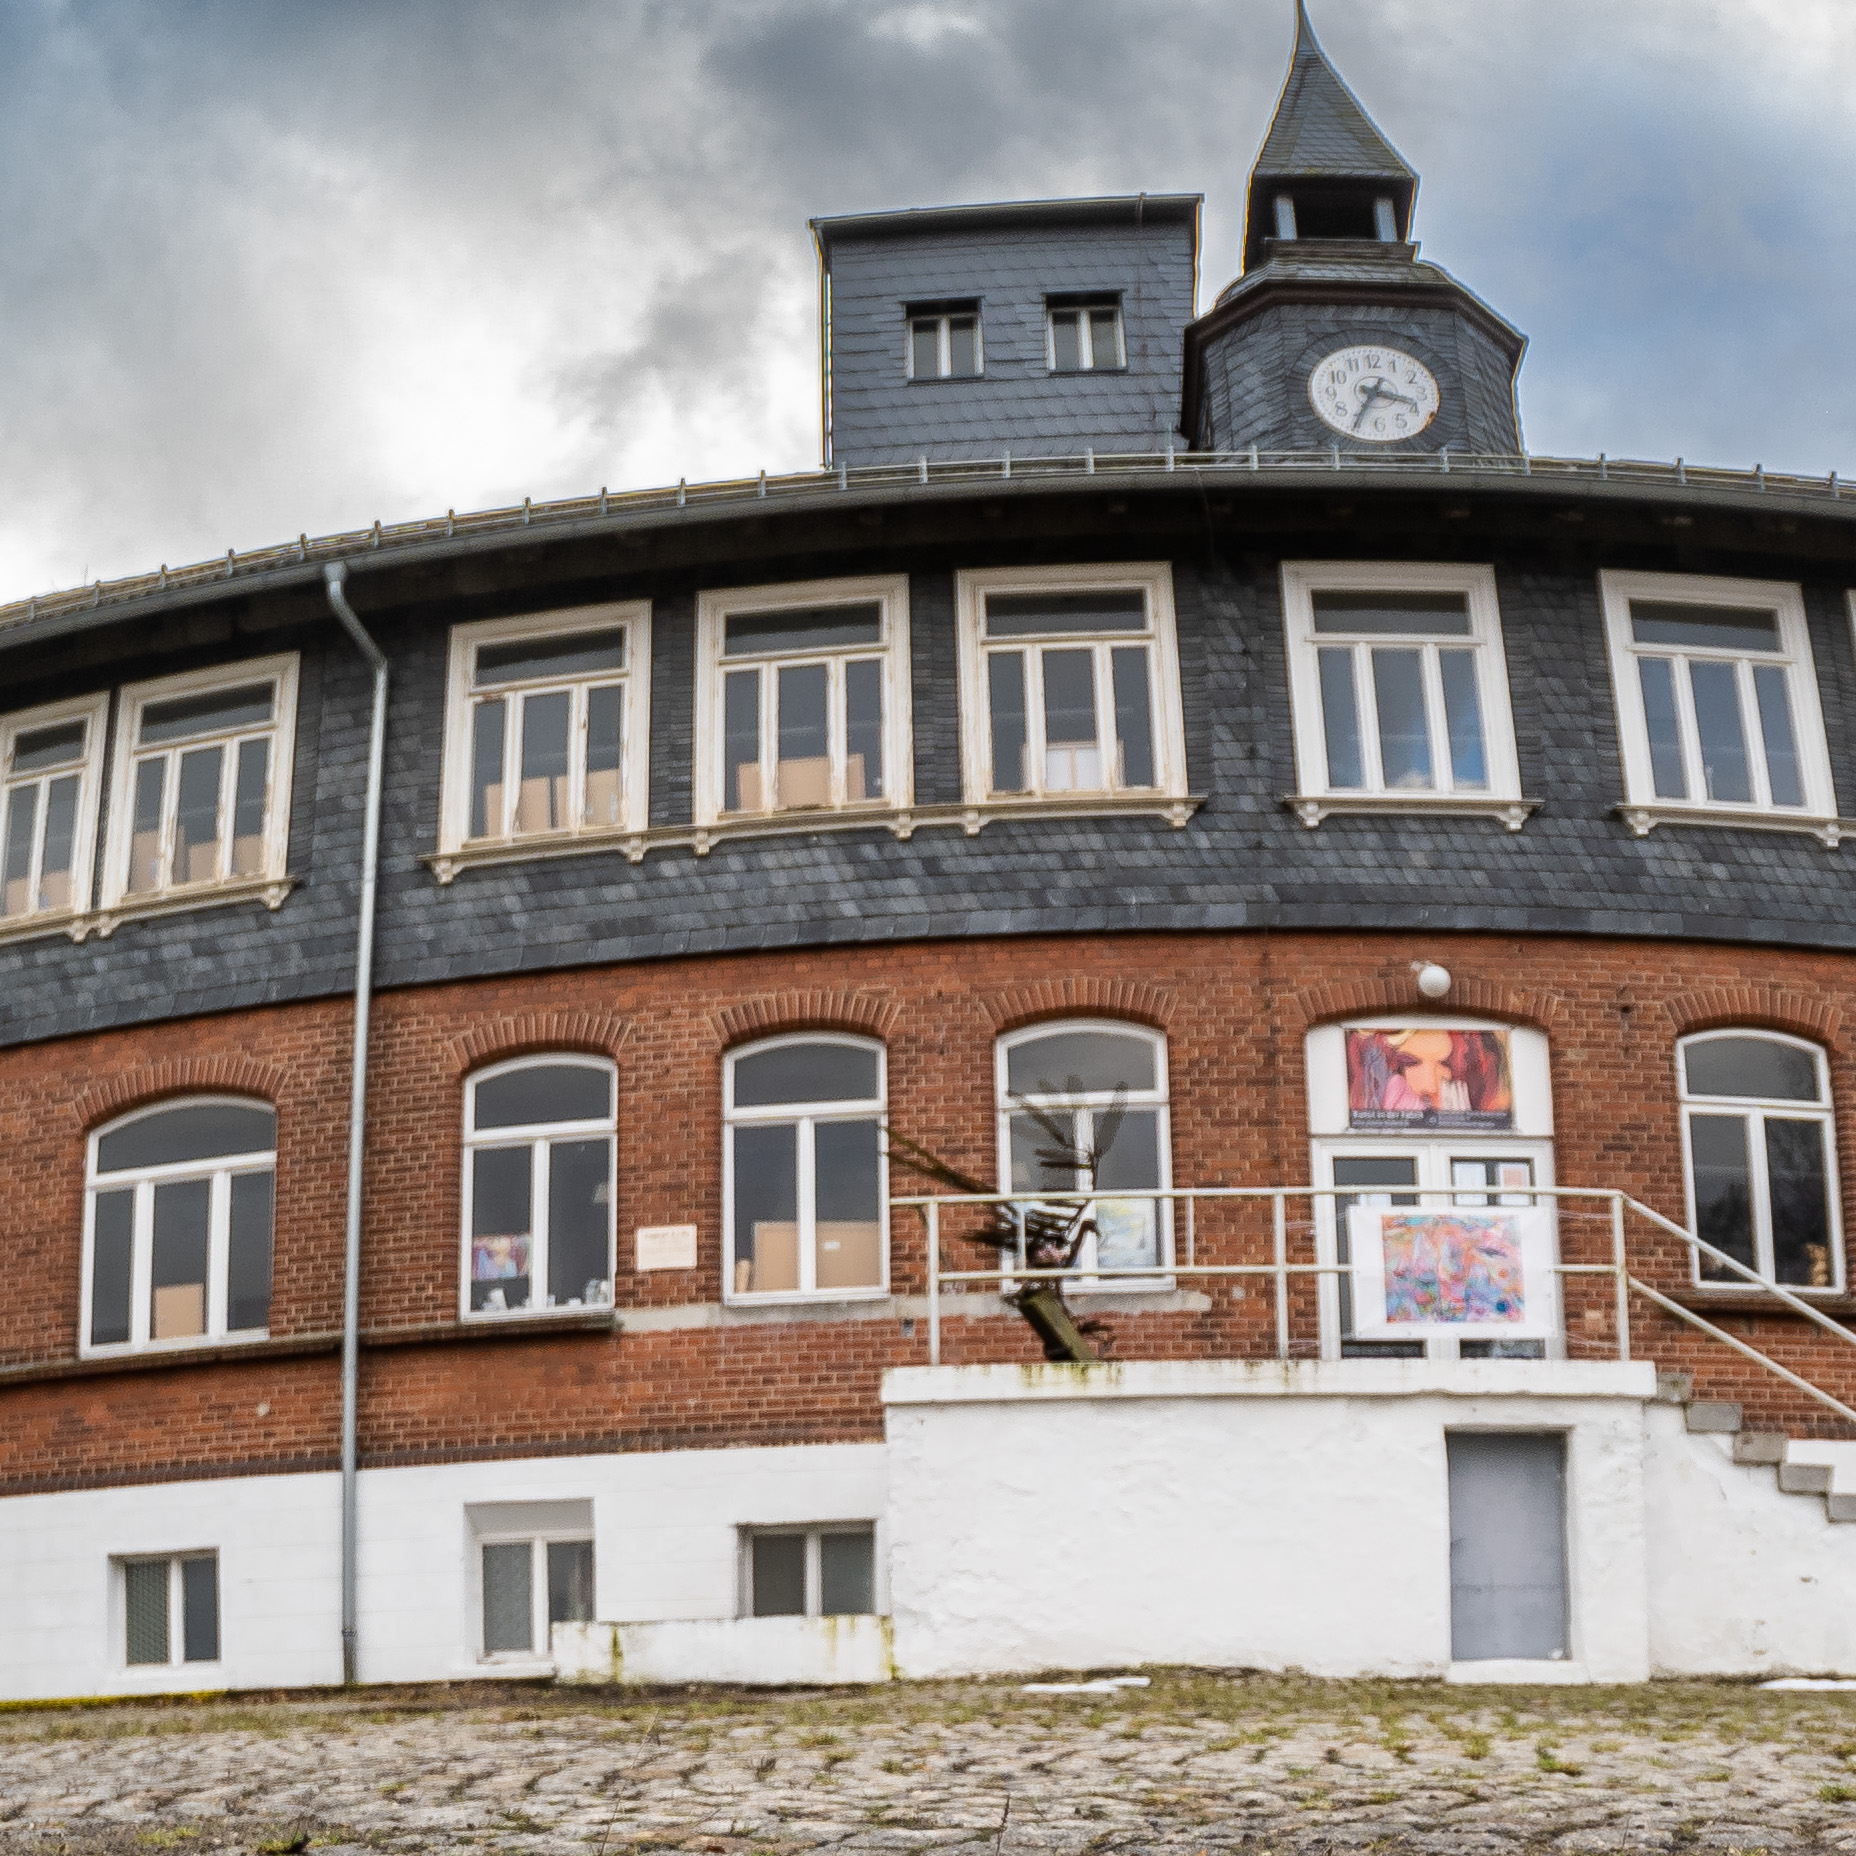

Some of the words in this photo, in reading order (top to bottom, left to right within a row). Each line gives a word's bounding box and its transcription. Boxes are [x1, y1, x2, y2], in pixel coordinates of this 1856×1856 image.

[1346, 359, 1359, 373] 11
[1363, 355, 1381, 369] 12
[1388, 359, 1397, 373] 1
[1328, 370, 1347, 384] 10
[1406, 369, 1418, 384] 2
[1326, 386, 1337, 400] 9
[1335, 402, 1347, 417] 8
[1372, 417, 1386, 432] 6
[1393, 413, 1408, 429] 5
